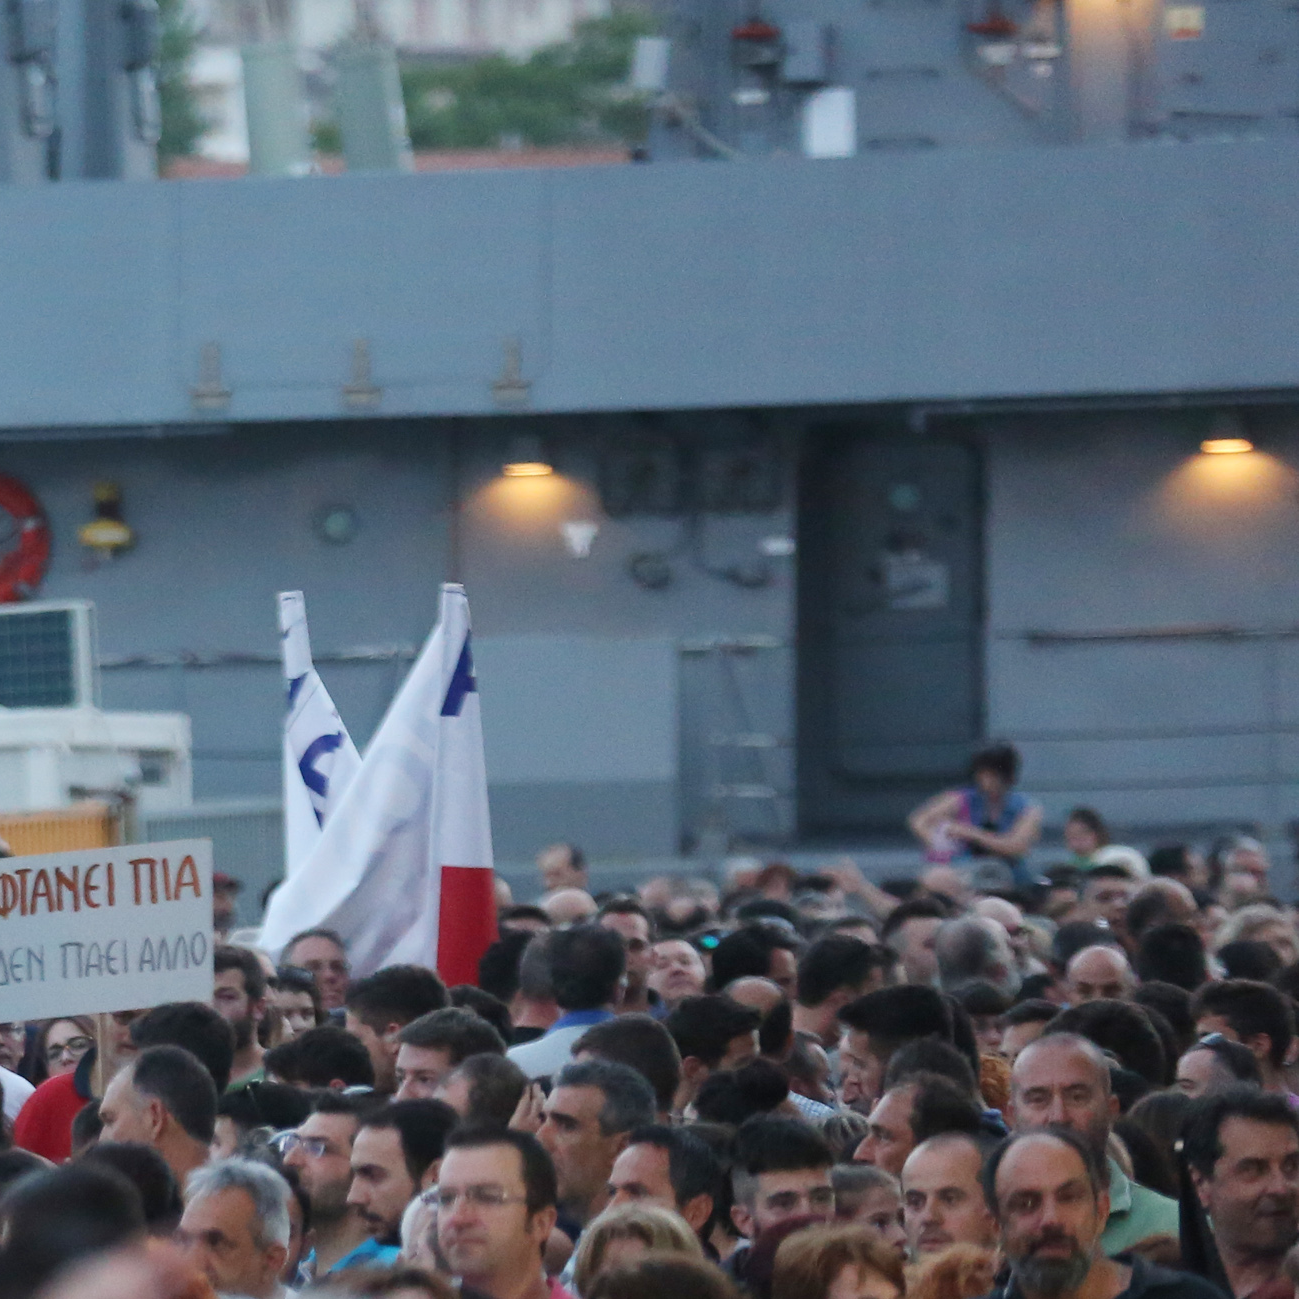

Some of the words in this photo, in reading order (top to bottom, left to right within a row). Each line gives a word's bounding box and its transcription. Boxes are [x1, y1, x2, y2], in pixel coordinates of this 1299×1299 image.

[128, 854, 201, 905] ΠΙΑ
[60, 938, 129, 979] ΠΑΕΙ
[138, 931, 208, 973] ΑΛΛΟ
